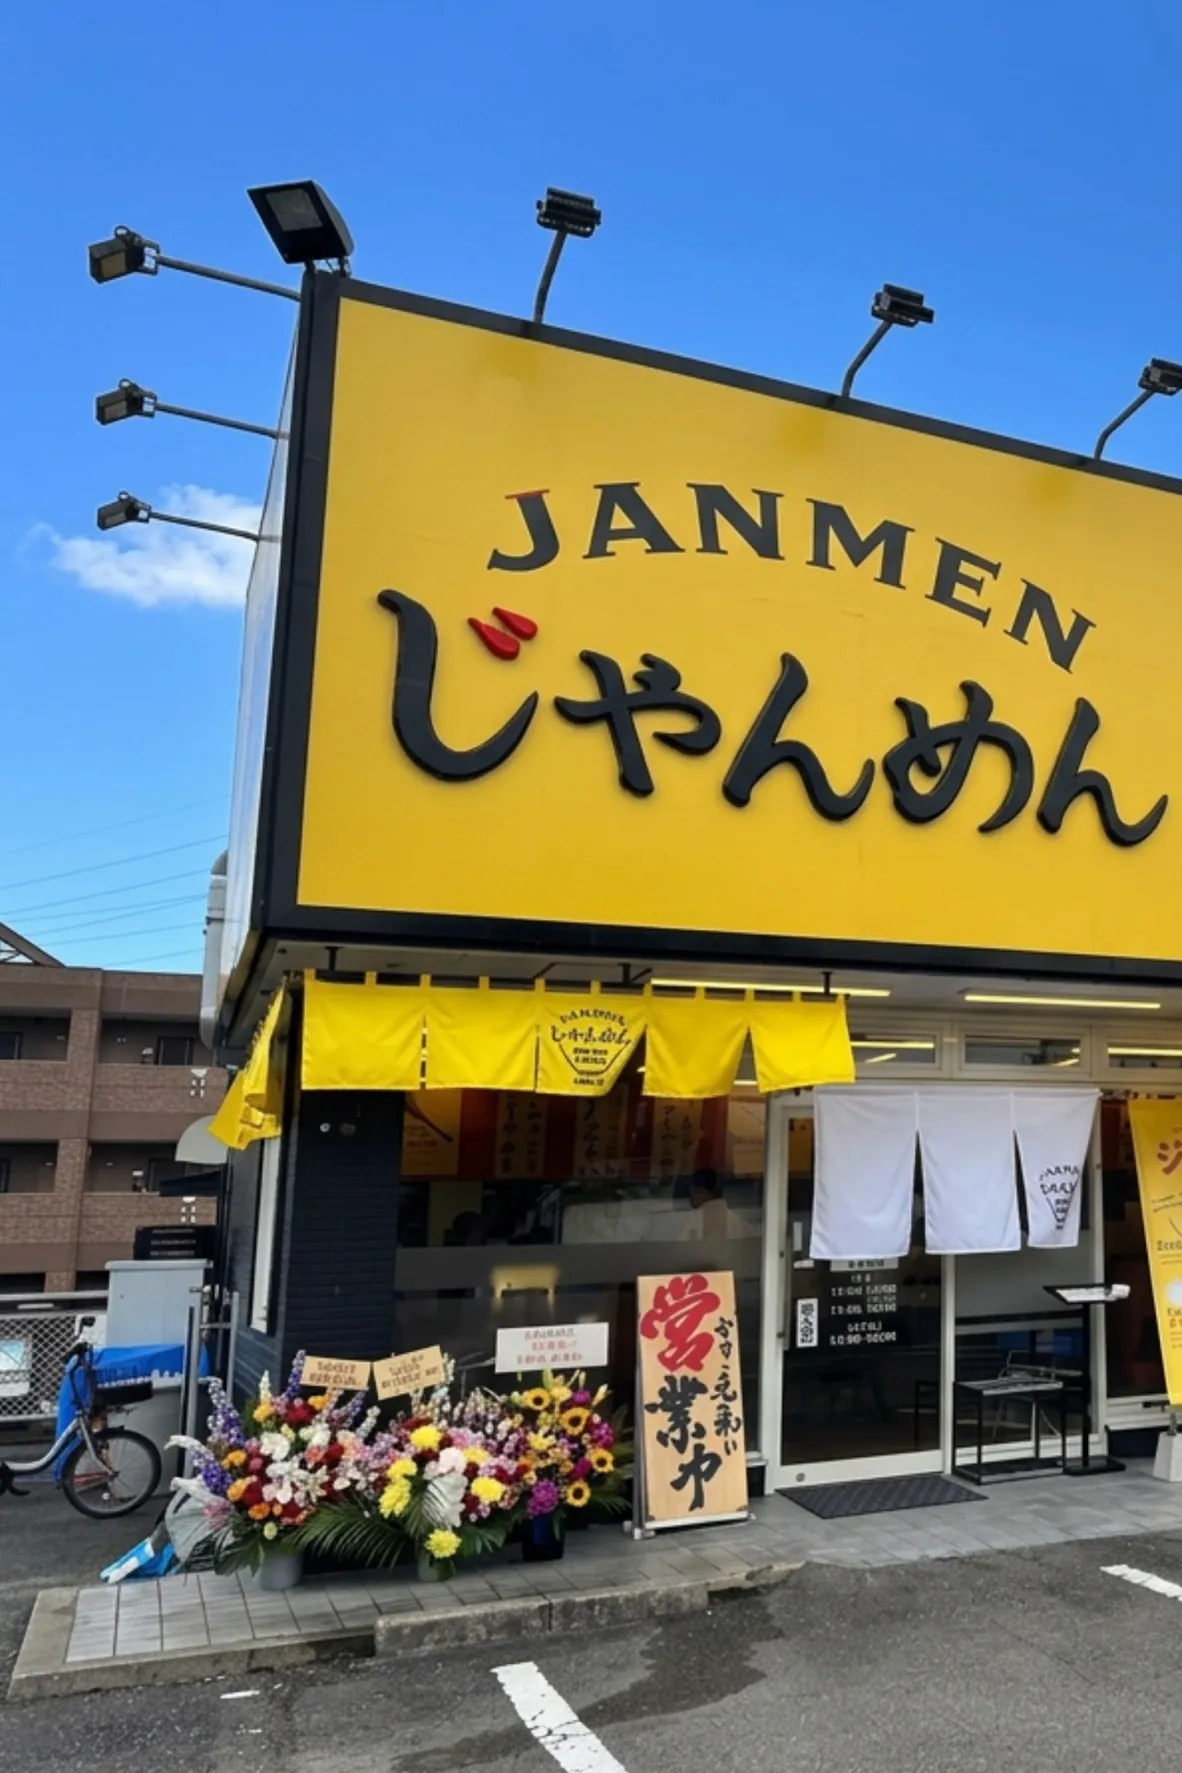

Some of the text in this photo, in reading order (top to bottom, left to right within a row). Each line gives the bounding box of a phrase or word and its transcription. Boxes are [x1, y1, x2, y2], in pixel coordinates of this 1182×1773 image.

[487, 482, 1096, 673] JANMEN
[378, 589, 1169, 847] じゃんめん
[640, 1274, 722, 1511] 営業中
